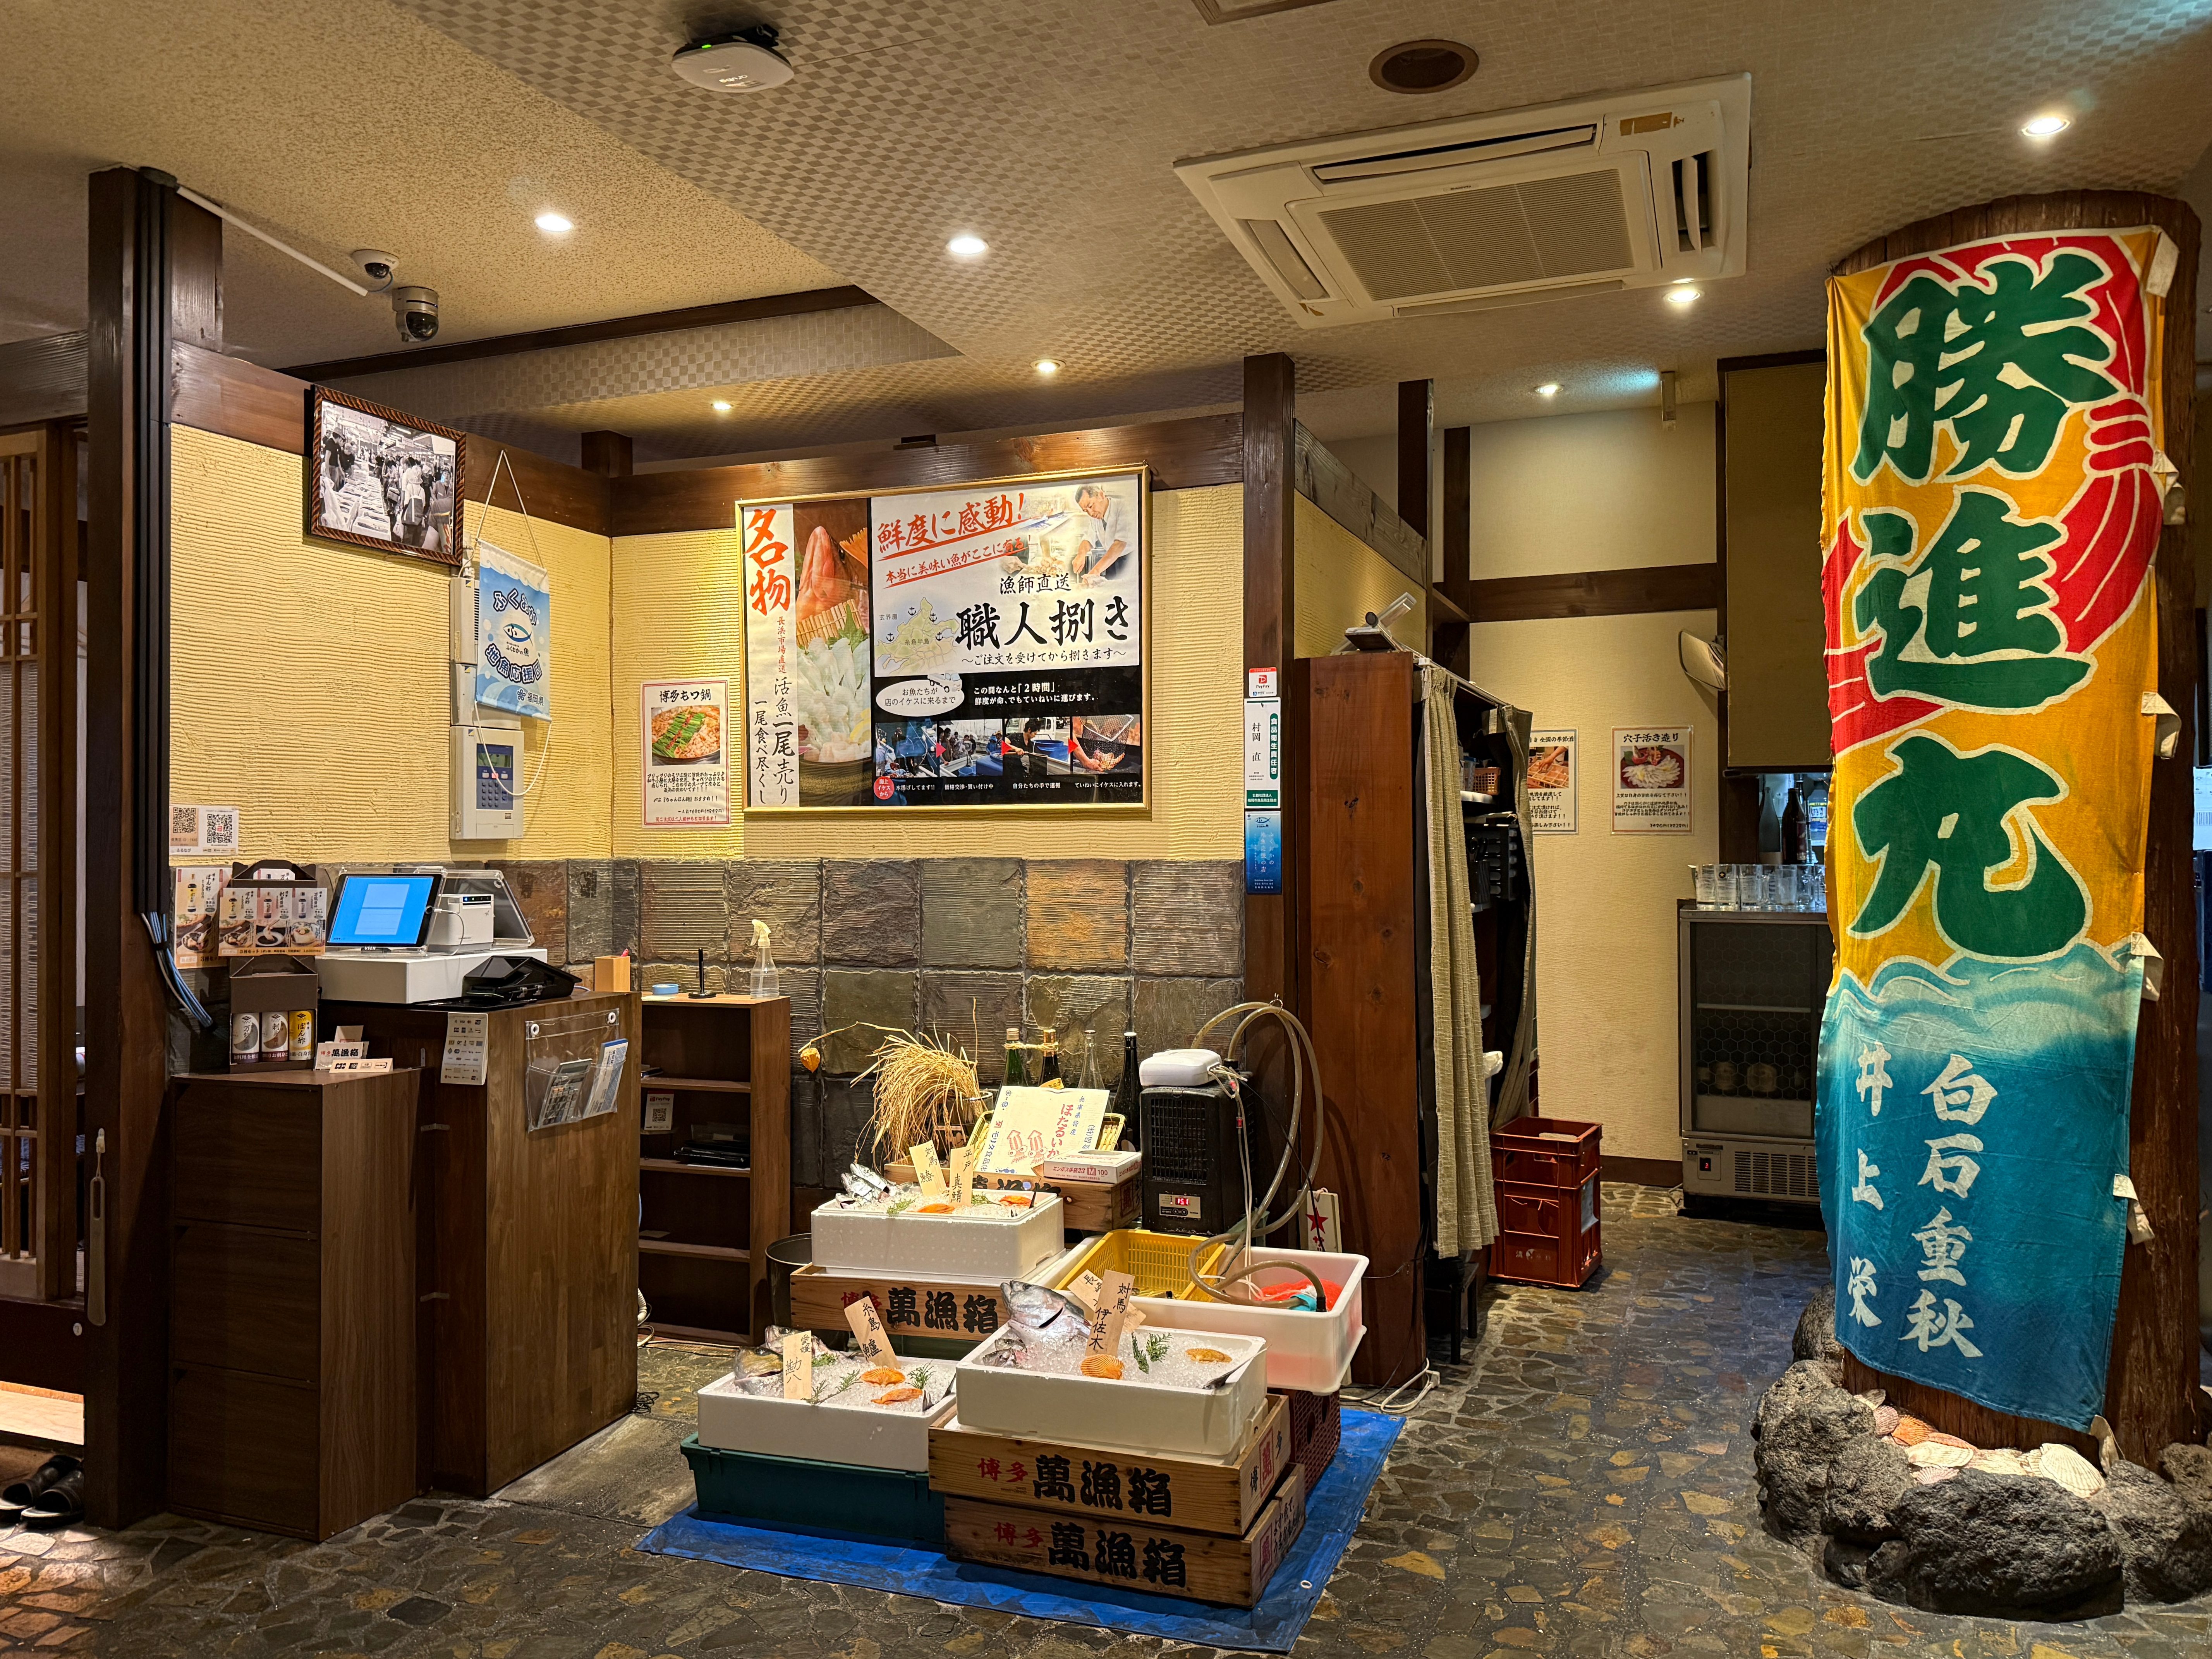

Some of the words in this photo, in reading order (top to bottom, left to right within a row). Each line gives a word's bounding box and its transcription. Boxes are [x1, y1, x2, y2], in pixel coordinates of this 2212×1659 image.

[743, 508, 790, 616] 名物
[1000, 573, 1072, 594] 漁師直送
[493, 588, 537, 626] ふくおか
[1850, 252, 2118, 957] 勝進丸
[955, 596, 1128, 650] 職人捌き
[777, 617, 788, 673] 長浜市場直送
[485, 643, 542, 684] 地魚応援団
[527, 692, 544, 706] 福岡県
[659, 689, 711, 702] 博多もつ鍋
[884, 697, 956, 706] 店のイケスに来るまで
[902, 687, 938, 696] お魚たちが
[772, 677, 795, 804] 活魚一尾売り
[1252, 722, 1261, 742] 村岡
[1623, 733, 1679, 742] 穴子活き造り
[754, 701, 769, 804] 一尾食べ尽くし
[1252, 752, 1261, 762] 直
[1070, 1096, 1085, 1135] 兵庫県特産
[1047, 1104, 1073, 1158] ほたるいか
[925, 1144, 938, 1167] 対馬
[963, 1149, 973, 1172] 平戸
[1899, 1054, 1999, 1358] 白石重秋
[1113, 1283, 1131, 1314] 対馬
[862, 1302, 881, 1332] 糸島
[1089, 1307, 1112, 1350] 伊佐木
[800, 1334, 810, 1353] 愛媛
[785, 1357, 802, 1384] 勘八
[977, 1458, 1028, 1483] 博多
[994, 1522, 1044, 1549] 博多
